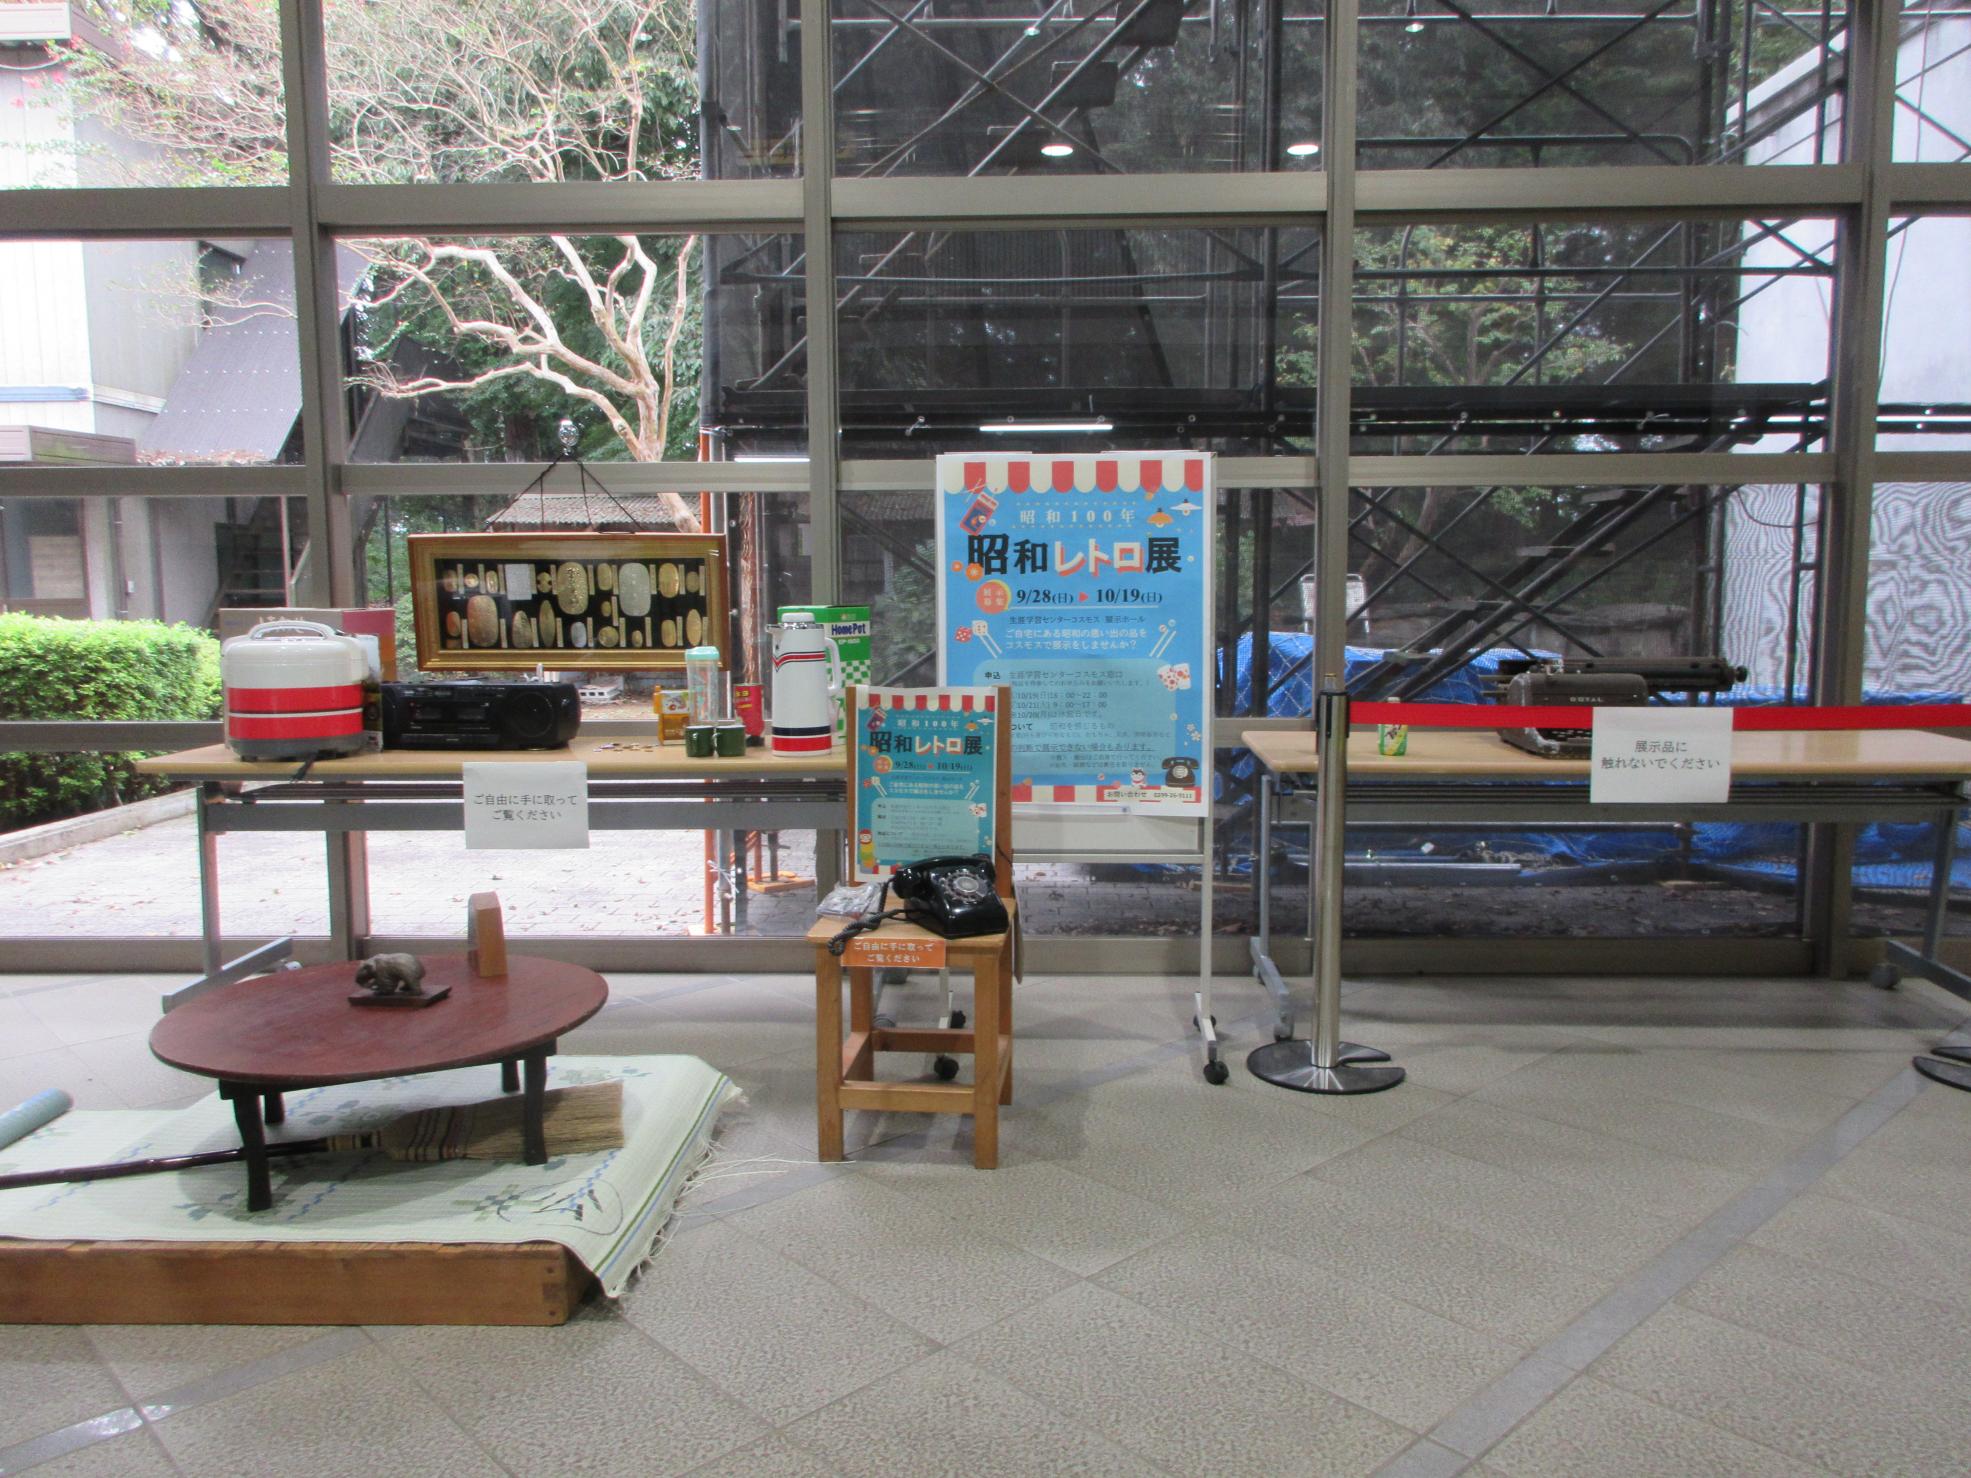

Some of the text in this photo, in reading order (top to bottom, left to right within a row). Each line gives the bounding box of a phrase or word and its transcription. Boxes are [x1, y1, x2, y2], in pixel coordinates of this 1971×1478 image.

[1019, 509, 1136, 525] 昭和100年
[967, 532, 1183, 578] 昭和レトロ展
[1016, 587, 1163, 604] 9/28(日) 10/19(日)
[869, 731, 983, 756] 昭和レトロ展
[1634, 740, 1688, 753] 展示品に
[1601, 756, 1721, 770] 触れないでください
[472, 794, 578, 806] ご自由に手に取って
[491, 809, 563, 821] ご覧ください
[853, 941, 936, 952] ご自由に手に取って
[866, 953, 920, 964] ご覧ください
